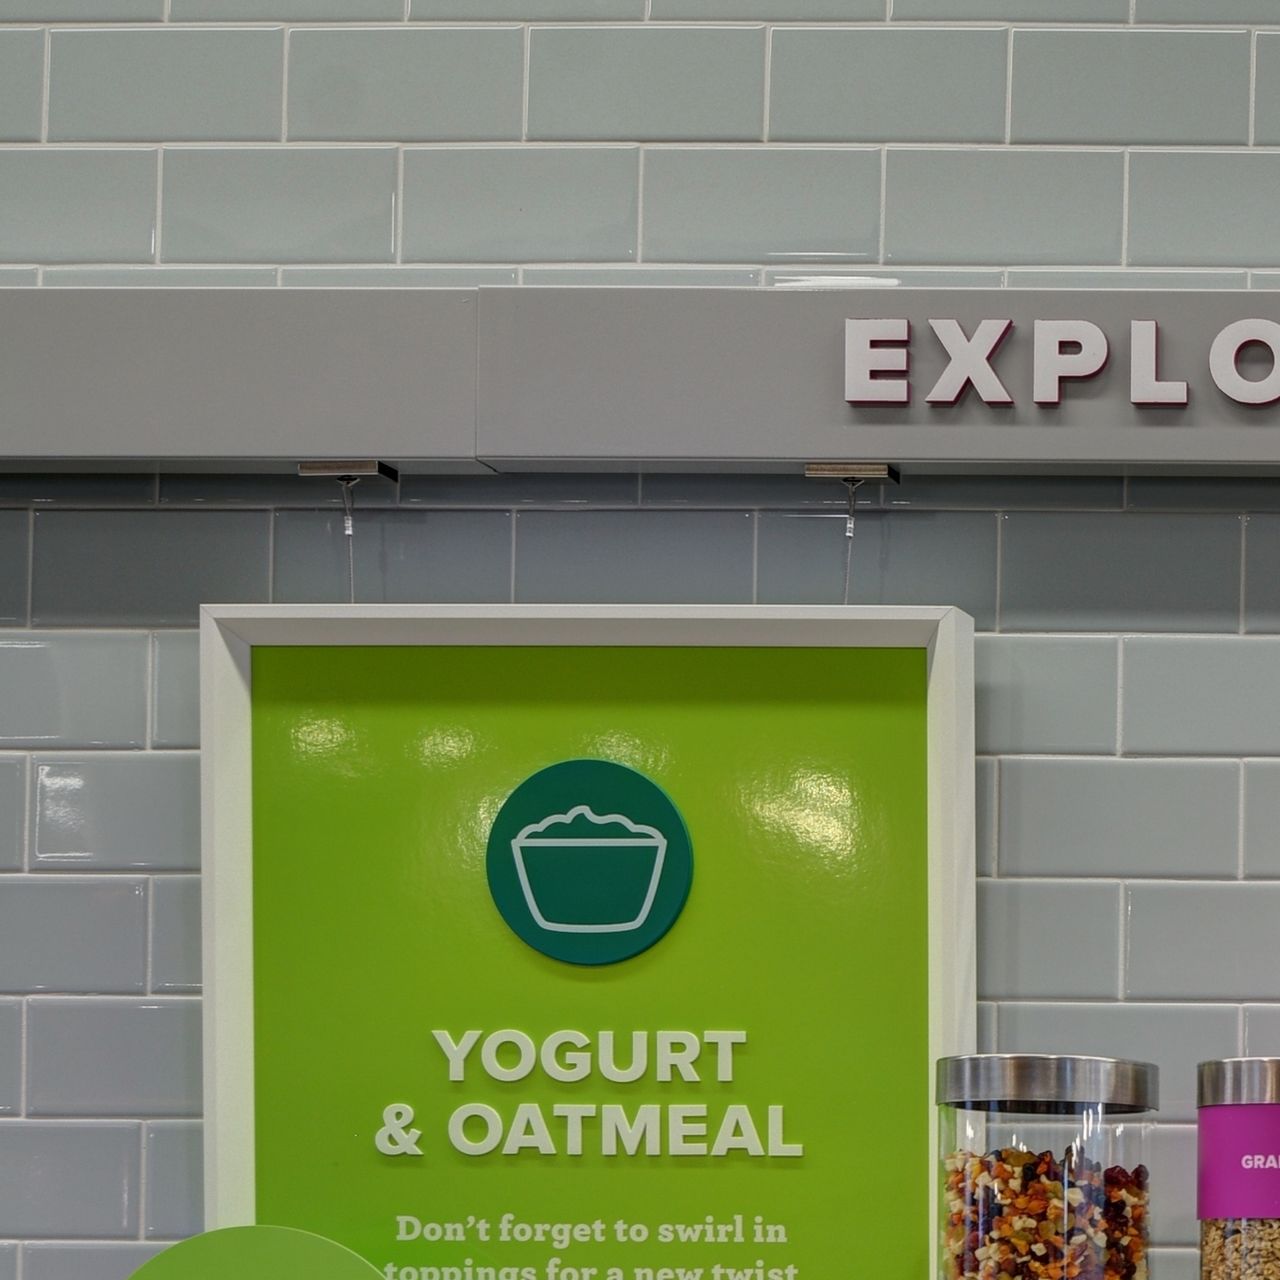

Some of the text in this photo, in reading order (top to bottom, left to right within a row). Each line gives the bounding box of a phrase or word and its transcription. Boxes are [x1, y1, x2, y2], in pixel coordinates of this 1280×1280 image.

[431, 1028, 747, 1083] YOGURT
[374, 1102, 804, 1157] & OATMEAL
[498, 1212, 606, 1250] forget
[613, 1219, 650, 1243] to
[657, 1214, 745, 1243] swirl
[753, 1215, 788, 1244] in
